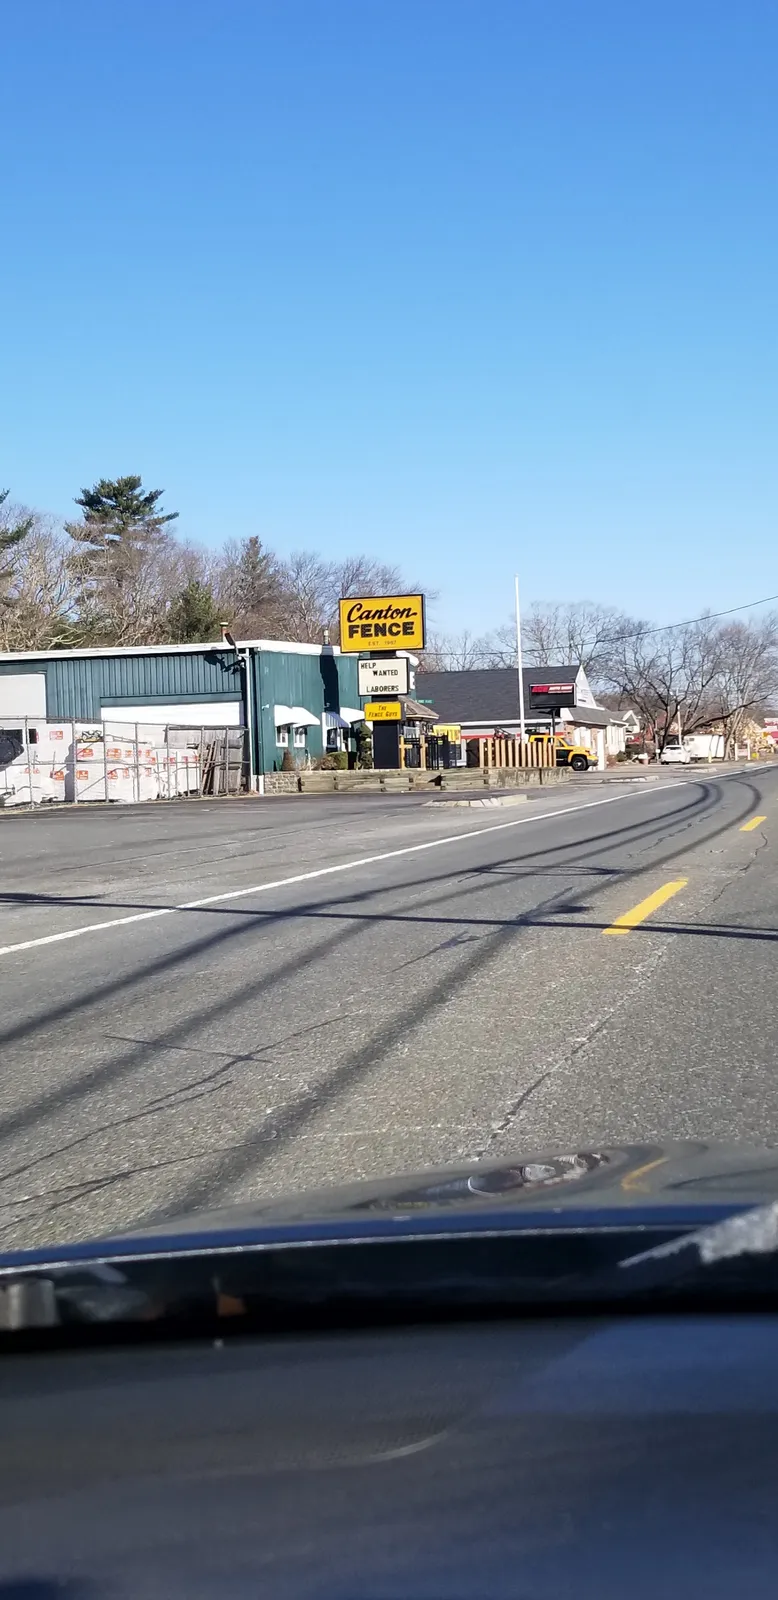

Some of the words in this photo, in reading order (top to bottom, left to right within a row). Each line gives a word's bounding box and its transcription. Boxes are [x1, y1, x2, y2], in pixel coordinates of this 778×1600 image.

[347, 602, 418, 623] Canton
[348, 621, 415, 638] FENCE
[366, 685, 399, 693] LABORERS
